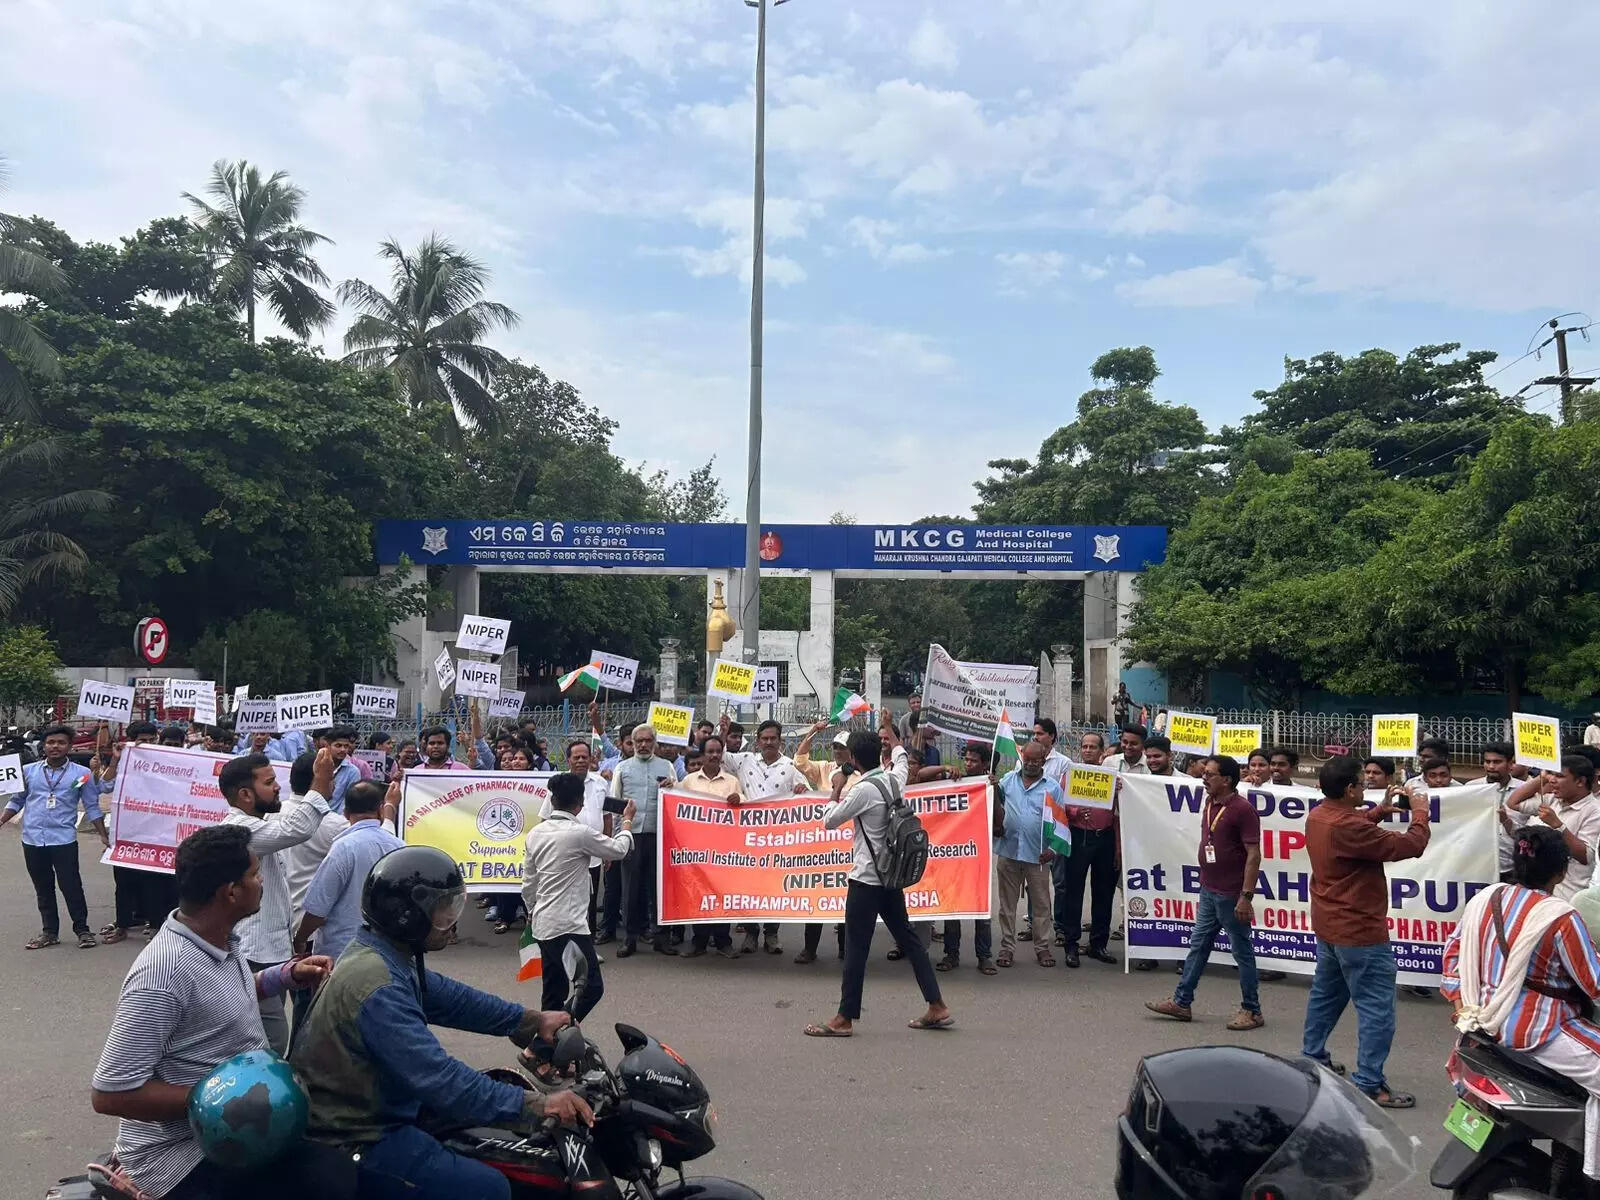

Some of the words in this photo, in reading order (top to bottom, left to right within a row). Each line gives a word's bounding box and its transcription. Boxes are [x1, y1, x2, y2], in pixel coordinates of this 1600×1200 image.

[502, 526, 527, 541] କେ
[975, 529, 1022, 539] Medical
[1026, 529, 1072, 541] College
[975, 540, 997, 549] And
[1002, 540, 1053, 551] Hospital
[874, 554, 902, 562] MAHARAJA
[904, 554, 929, 562] KRUSHNA
[931, 554, 956, 562] CHANDRA
[957, 554, 982, 563] GAJAPATI
[984, 554, 1006, 563] MEDICAL
[1008, 554, 1032, 563] COLLEGE
[1033, 554, 1045, 563] AND
[1046, 554, 1073, 563] HOSPITAL
[465, 623, 504, 640] NIPER
[462, 669, 497, 685] NIPER
[719, 664, 750, 678] NIPER
[715, 679, 748, 693] BRAHMAPUR
[84, 691, 129, 711] NIPER
[173, 689, 197, 699] NIP
[356, 695, 395, 709] NIPER
[493, 695, 520, 709] NIPER
[281, 704, 331, 721] NIPER
[655, 707, 686, 720] NIPER
[1173, 716, 1208, 730] NIPER
[1378, 720, 1410, 730] NIPER
[1519, 721, 1551, 737] NIPER
[1172, 731, 1207, 745] BRAHMAPUR
[1221, 729, 1255, 739] NIPER
[1378, 736, 1410, 747] BRAHMAPUR
[1521, 743, 1553, 758] BRAHMAPUR
[133, 760, 149, 773] We
[152, 762, 193, 778] Demand
[1073, 769, 1109, 783] NIPER
[1071, 786, 1107, 799] BRAHMAPUR
[1165, 783, 1205, 814] W
[124, 796, 150, 814] National
[178, 803, 184, 817] of
[406, 815, 416, 828] OM
[416, 802, 432, 816] SAI
[434, 788, 464, 808] COLLEGE
[464, 784, 474, 795] OF
[476, 781, 517, 794] PHARMACY
[518, 783, 534, 794] AND
[676, 804, 734, 825] MILITA
[739, 805, 830, 826] KRIYANUS
[906, 793, 969, 814] MITTEE
[745, 826, 854, 847] Establishme
[469, 841, 517, 856] Supports
[671, 849, 708, 864] National
[712, 851, 756, 867] Institute
[759, 850, 770, 867] of
[773, 849, 854, 868] Pharmaceutical
[784, 871, 849, 892] (NIPER
[1127, 863, 1166, 892] at
[700, 895, 720, 911] AT-
[723, 895, 814, 913] BERHAMPUR,
[1263, 908, 1310, 931] COLL
[1129, 921, 1153, 930] Near
[1258, 930, 1301, 945] Square,
[1412, 945, 1445, 955] Pand
